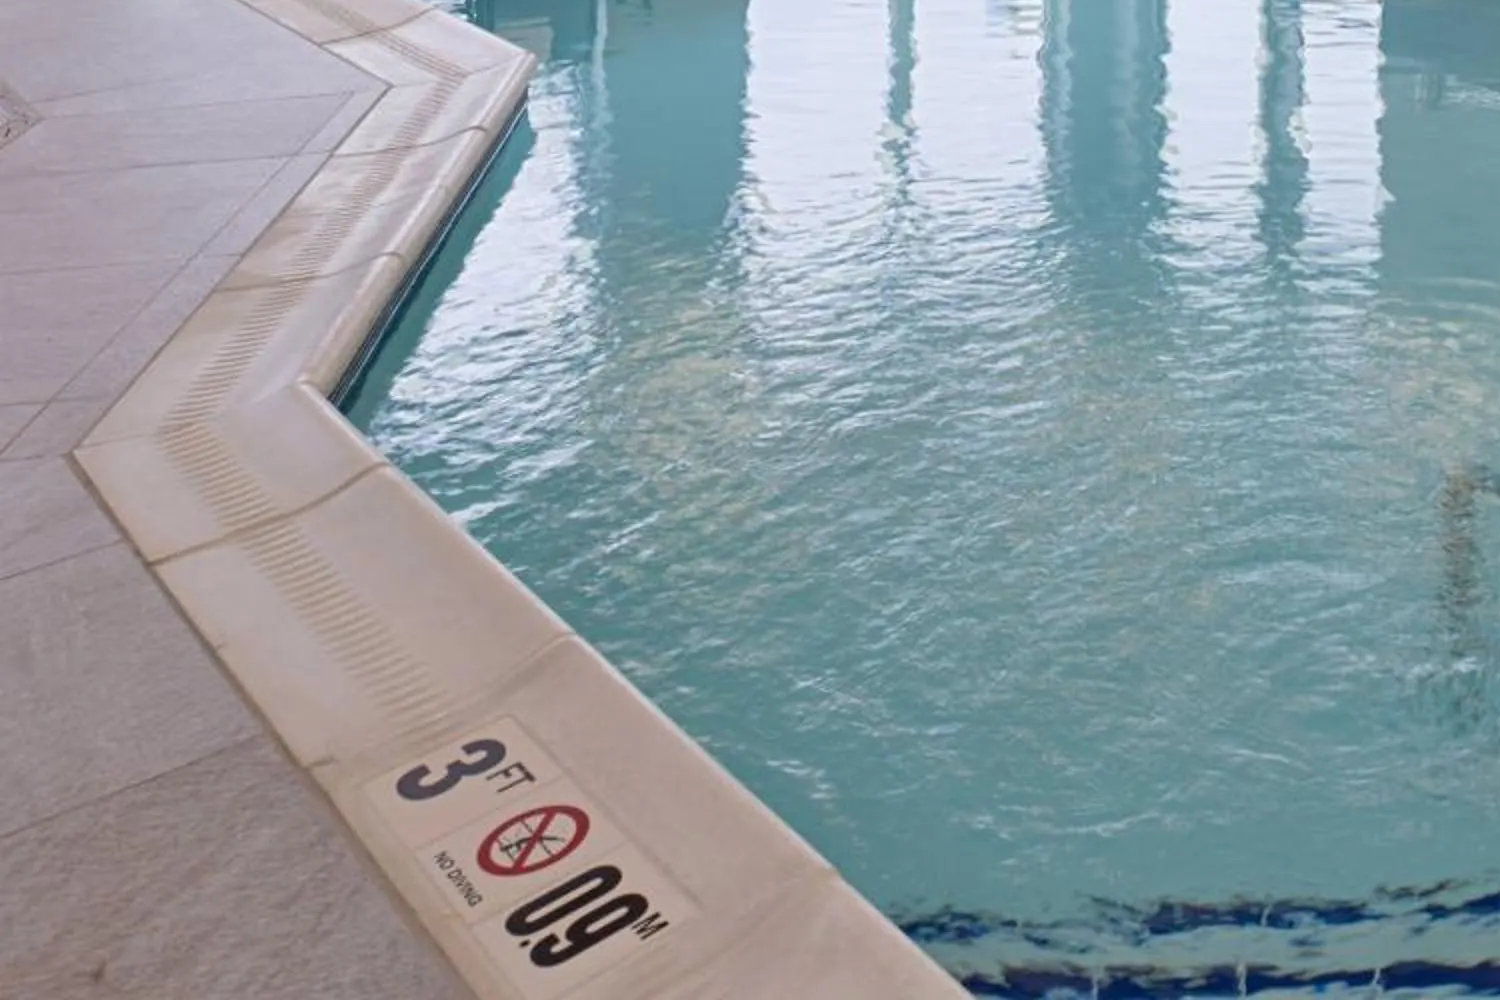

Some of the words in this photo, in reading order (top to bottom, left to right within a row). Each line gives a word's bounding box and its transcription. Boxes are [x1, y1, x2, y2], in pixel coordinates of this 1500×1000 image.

[396, 738, 507, 801] 3
[485, 761, 536, 793] FT
[433, 850, 455, 870] NO
[447, 867, 483, 907] DIVING
[631, 911, 670, 940] M
